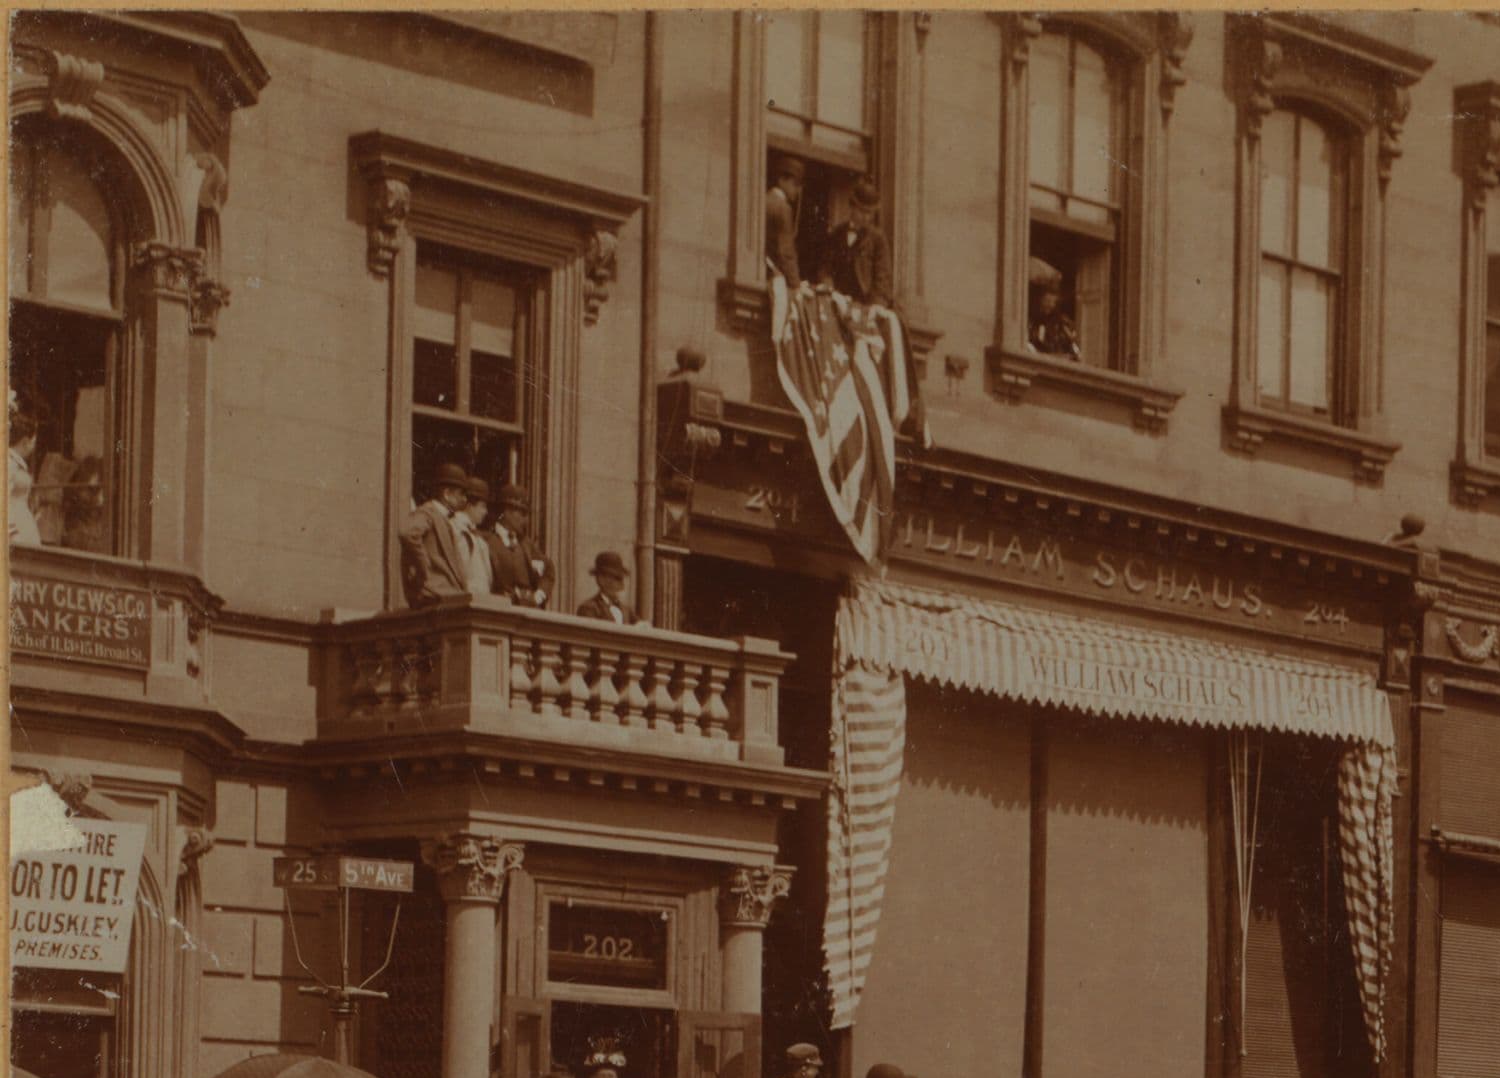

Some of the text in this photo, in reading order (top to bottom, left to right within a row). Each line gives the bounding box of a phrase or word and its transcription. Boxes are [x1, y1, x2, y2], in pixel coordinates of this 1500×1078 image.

[903, 513, 1064, 581] ILLIAM
[1303, 602, 1350, 633] 204
[1029, 654, 1136, 698] WILLIAM
[50, 862, 78, 902] TO
[292, 860, 317, 883] 25
[584, 933, 634, 961] 202
